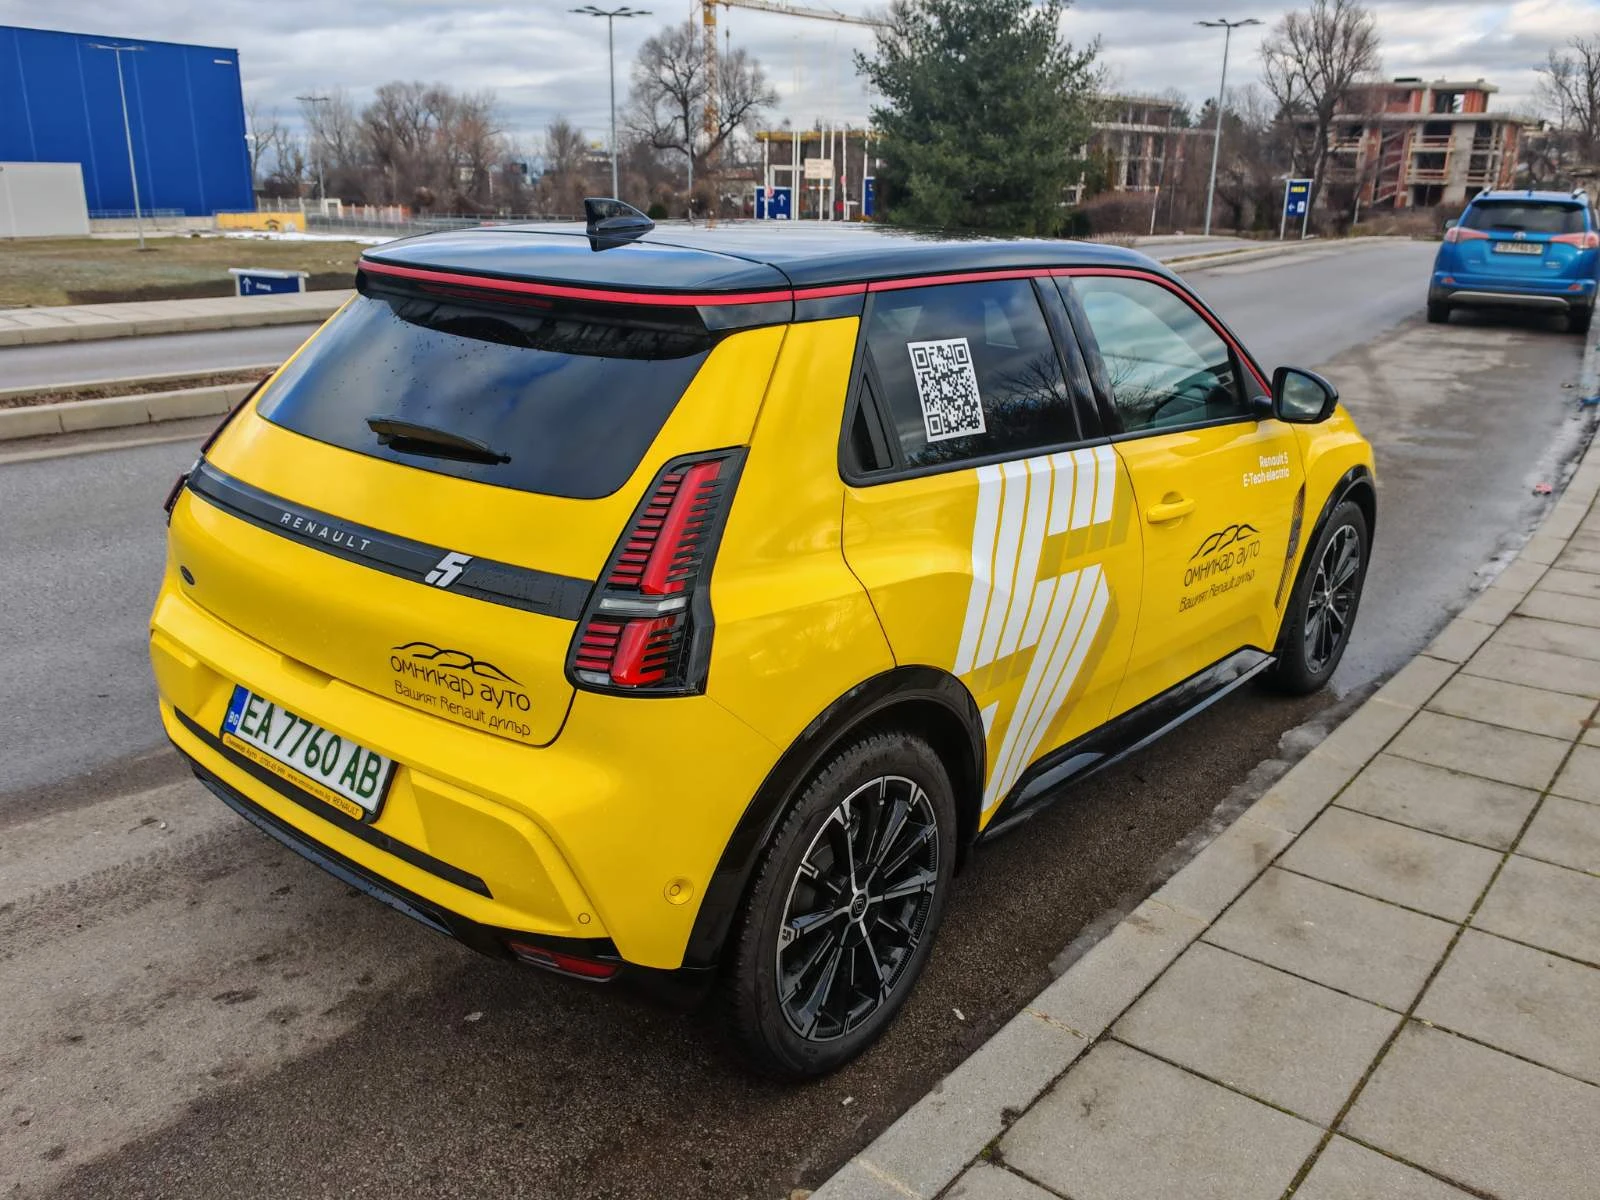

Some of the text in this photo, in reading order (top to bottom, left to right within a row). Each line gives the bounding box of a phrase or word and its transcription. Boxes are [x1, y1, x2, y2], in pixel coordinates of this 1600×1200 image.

[1259, 453, 1283, 468] Renault
[1243, 467, 1290, 488] E-Tech electric
[280, 512, 473, 588] RENAULT 5
[1236, 540, 1261, 568] ауто
[1209, 576, 1235, 598] Renault
[390, 655, 531, 712] омникар ауто
[394, 679, 437, 706] Вашият
[440, 695, 486, 725] Renault
[227, 711, 239, 726] BG
[273, 710, 342, 777] 7760
[332, 796, 360, 817] RENAULT
